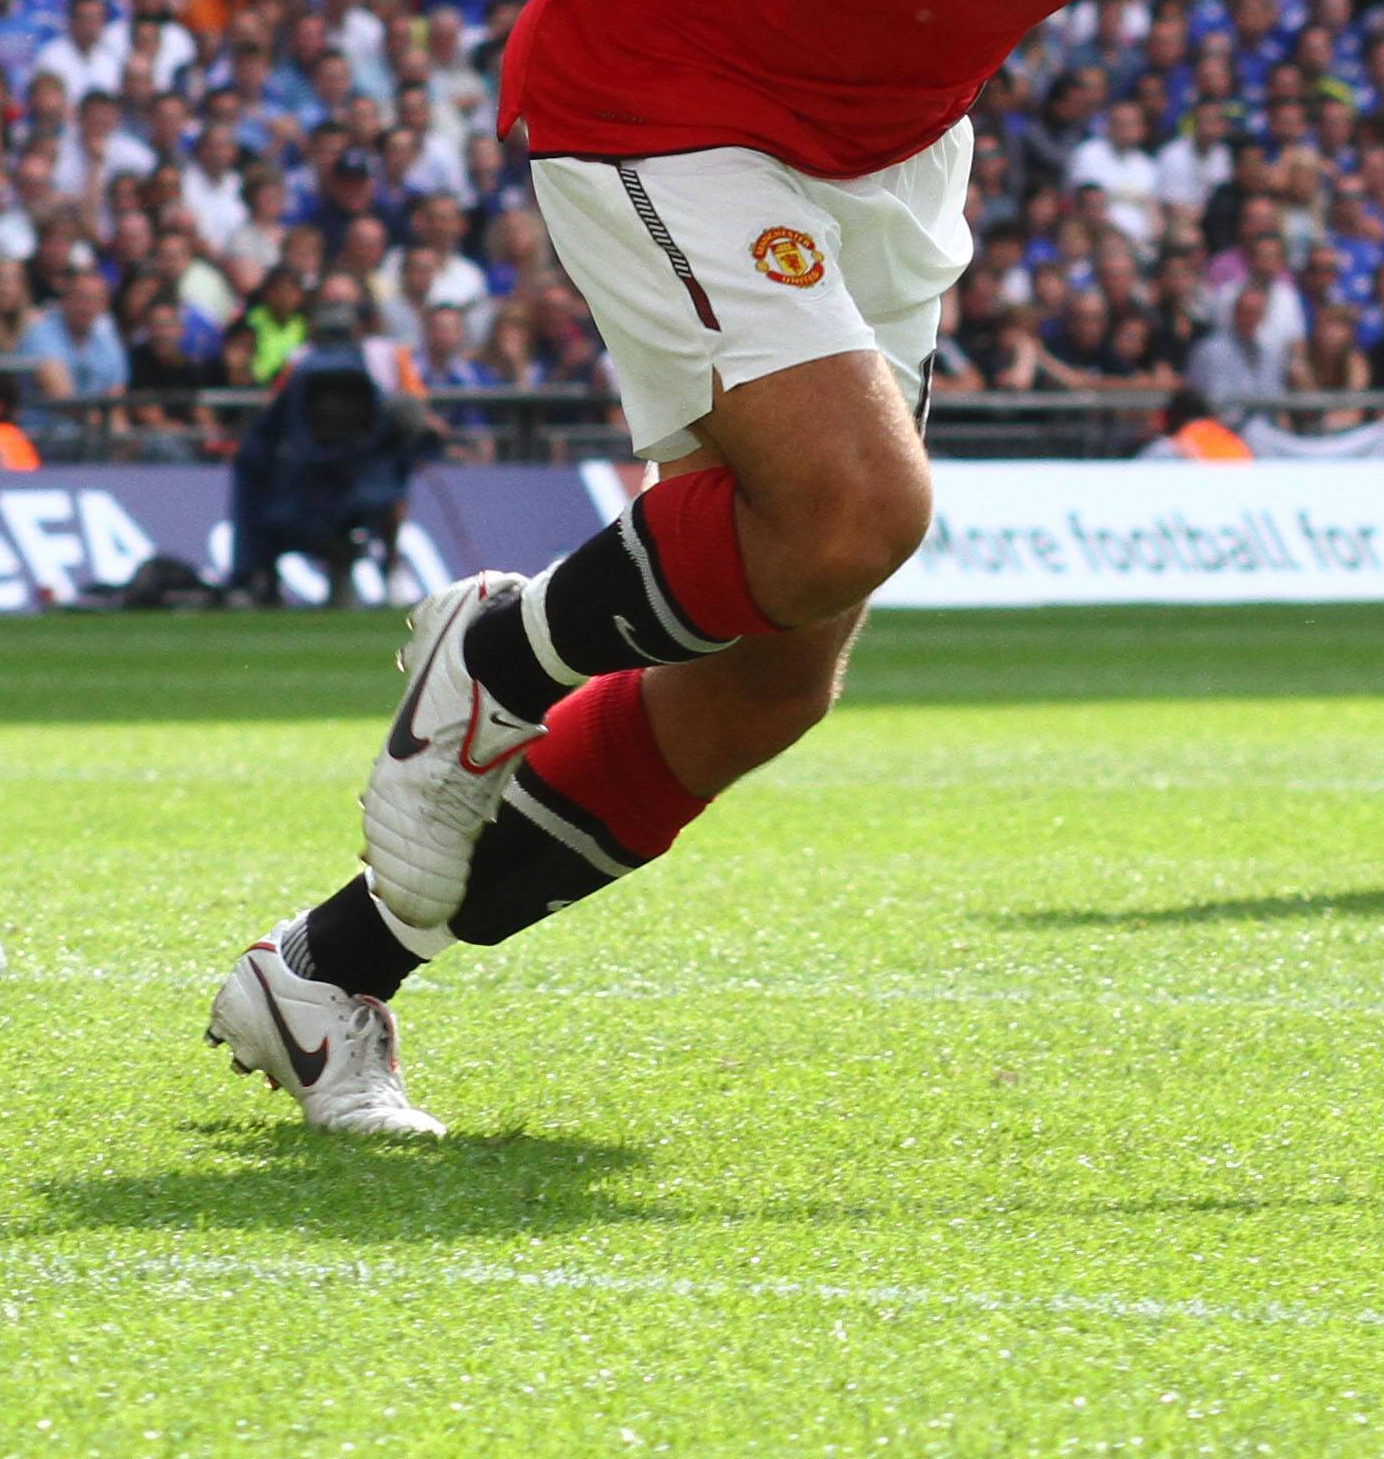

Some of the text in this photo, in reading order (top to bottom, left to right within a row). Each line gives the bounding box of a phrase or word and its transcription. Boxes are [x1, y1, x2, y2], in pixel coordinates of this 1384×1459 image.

[920, 510, 1063, 575] More
[1068, 508, 1300, 574] football
[1300, 509, 1381, 571] for
